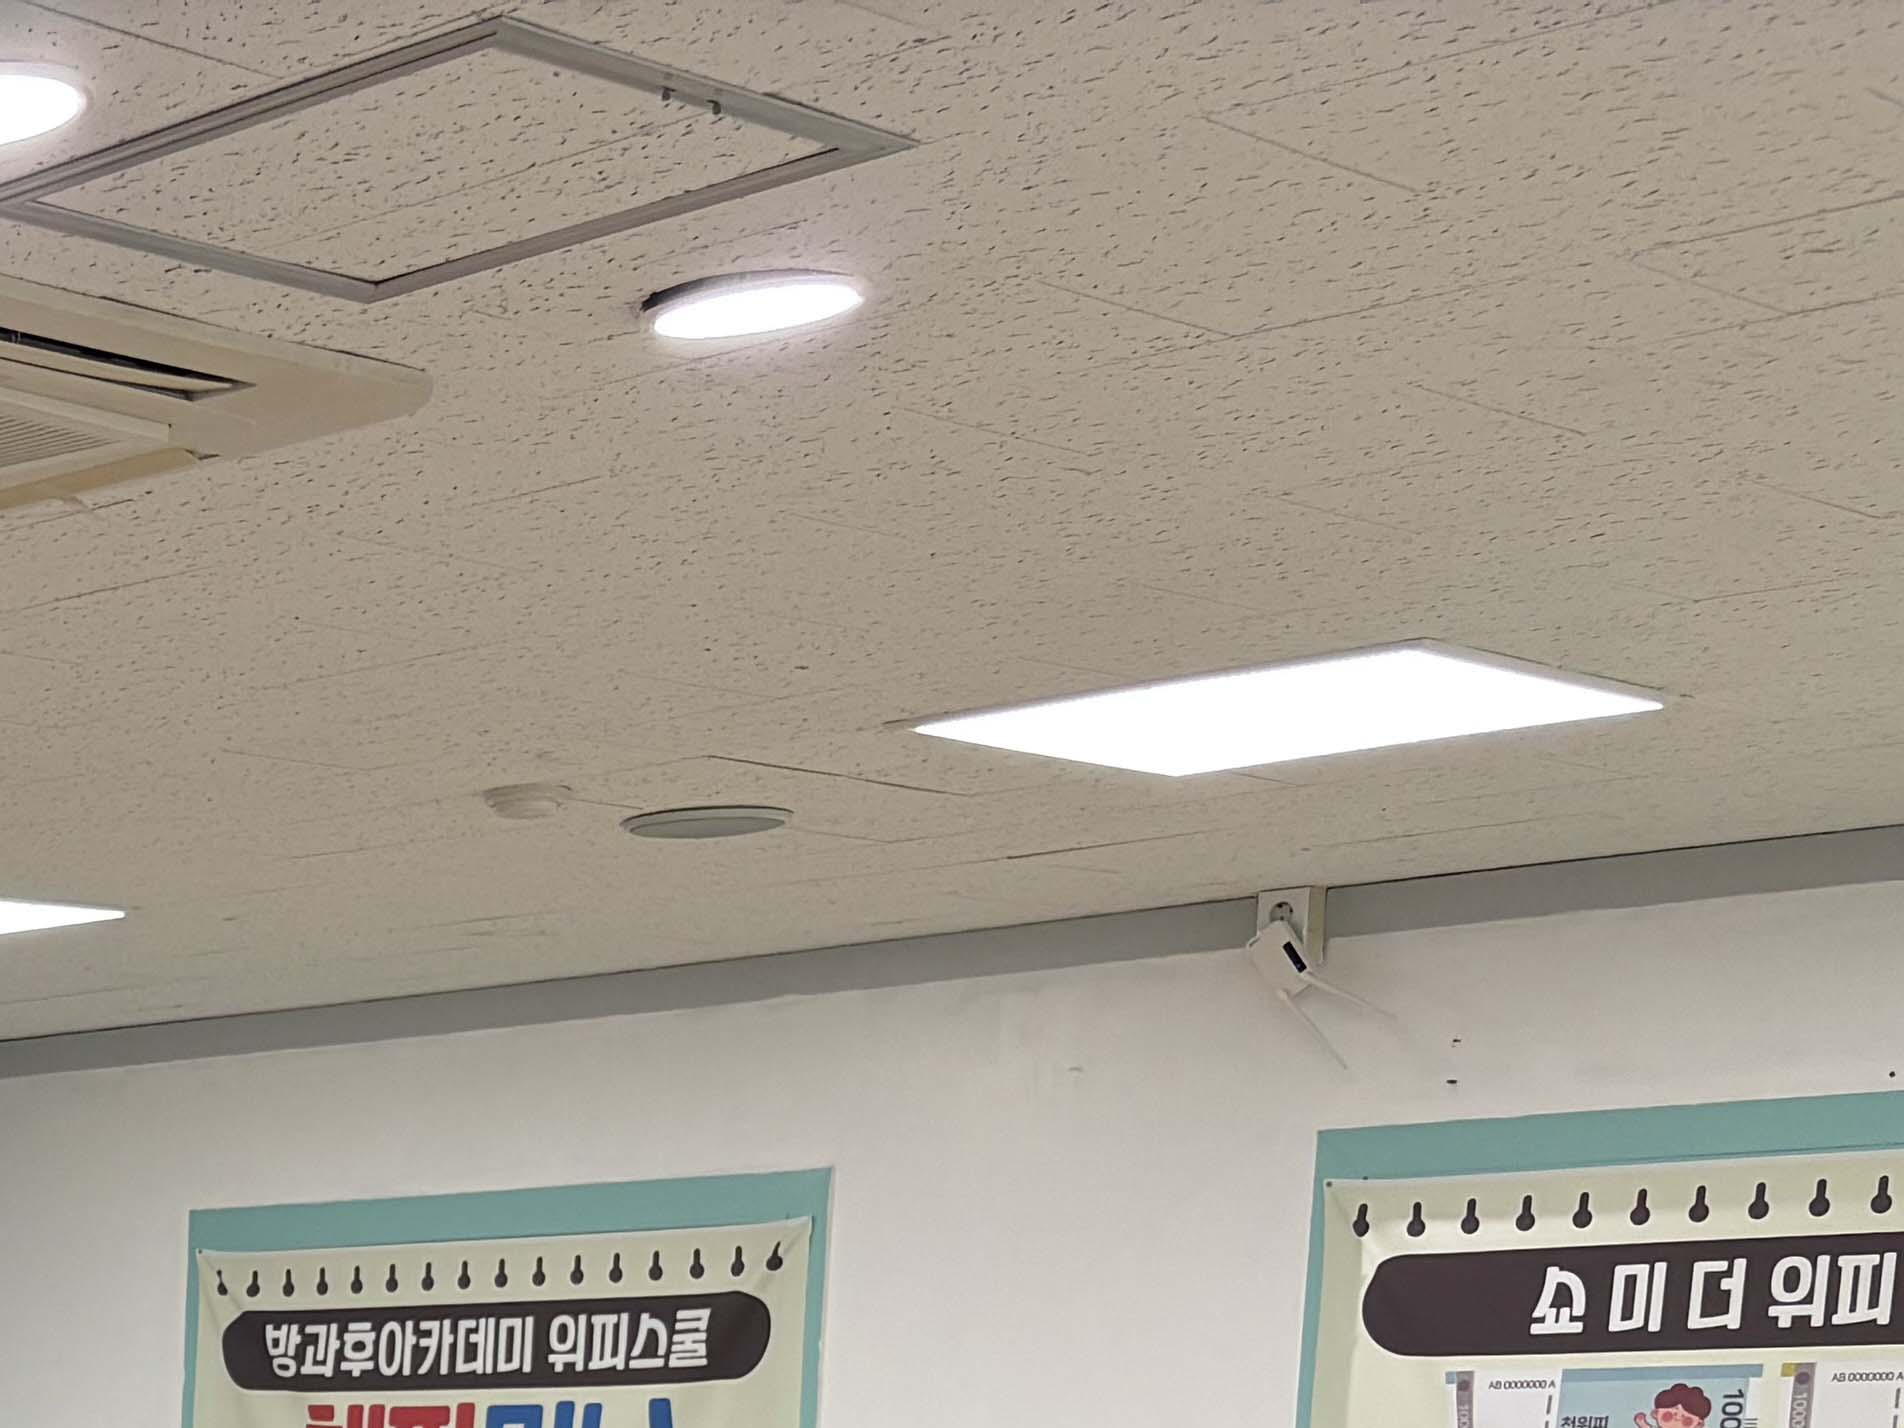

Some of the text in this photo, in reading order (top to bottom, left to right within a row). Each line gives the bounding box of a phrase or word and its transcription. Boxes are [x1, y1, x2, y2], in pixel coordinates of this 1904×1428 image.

[1530, 1266, 1587, 1334] 쇼
[1608, 1262, 1666, 1332] 미
[1687, 1259, 1746, 1329] 더
[266, 1308, 711, 1378] 방과후아카데미 위피스쿨
